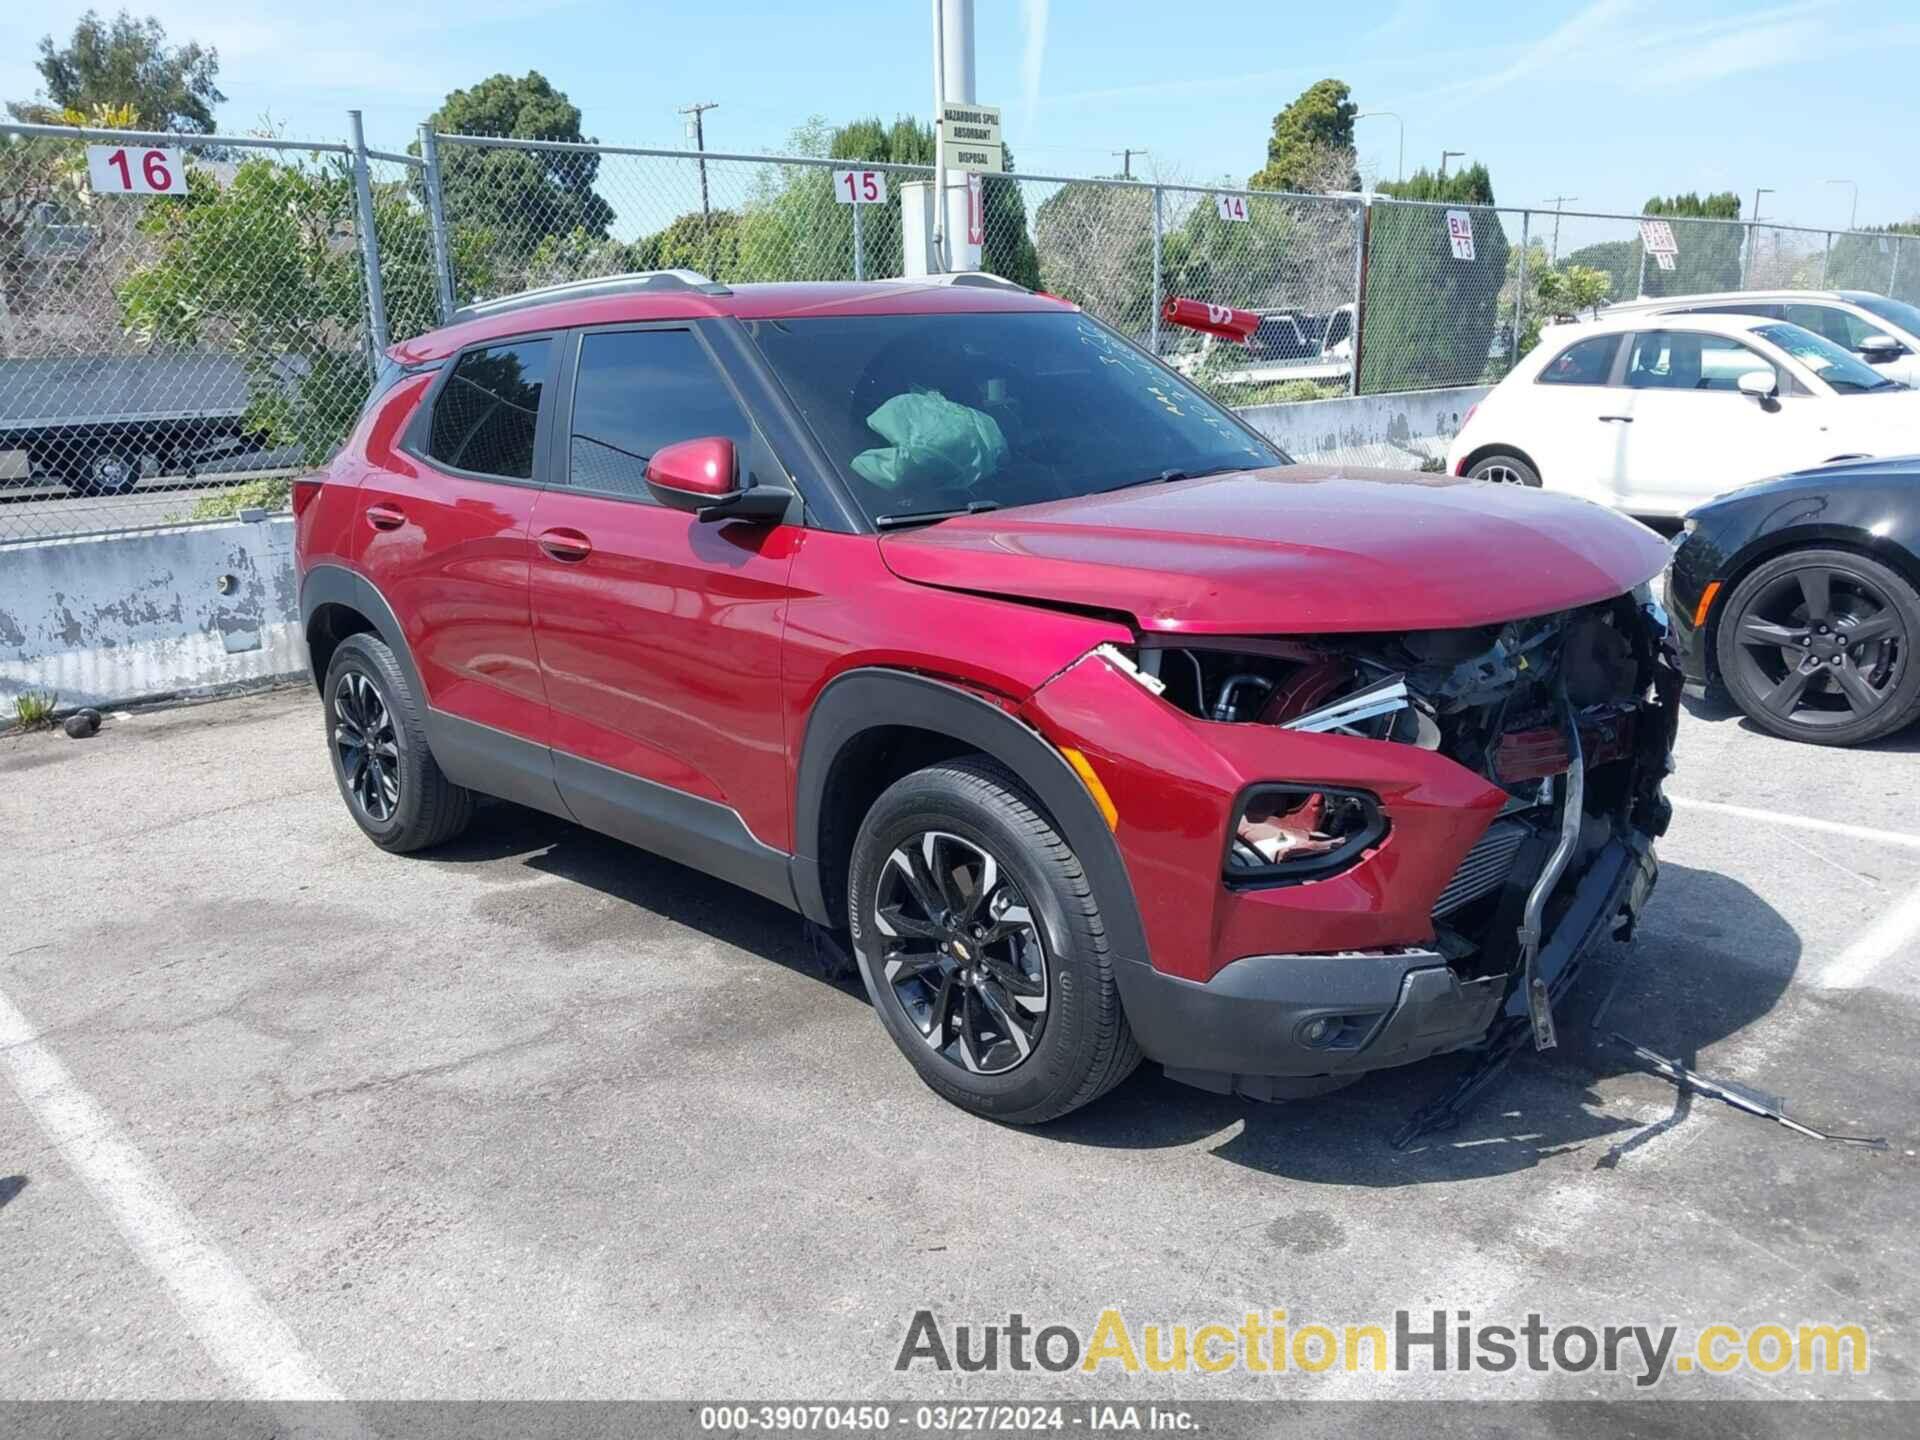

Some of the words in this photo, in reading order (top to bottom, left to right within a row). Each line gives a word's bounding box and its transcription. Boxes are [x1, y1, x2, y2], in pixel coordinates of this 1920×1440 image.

[958, 151, 988, 165] DISPOSAL
[108, 149, 172, 191] 16
[844, 173, 877, 201] 15
[1223, 197, 1244, 219] 14
[1451, 217, 1470, 235] BW
[1456, 240, 1472, 258] 13
